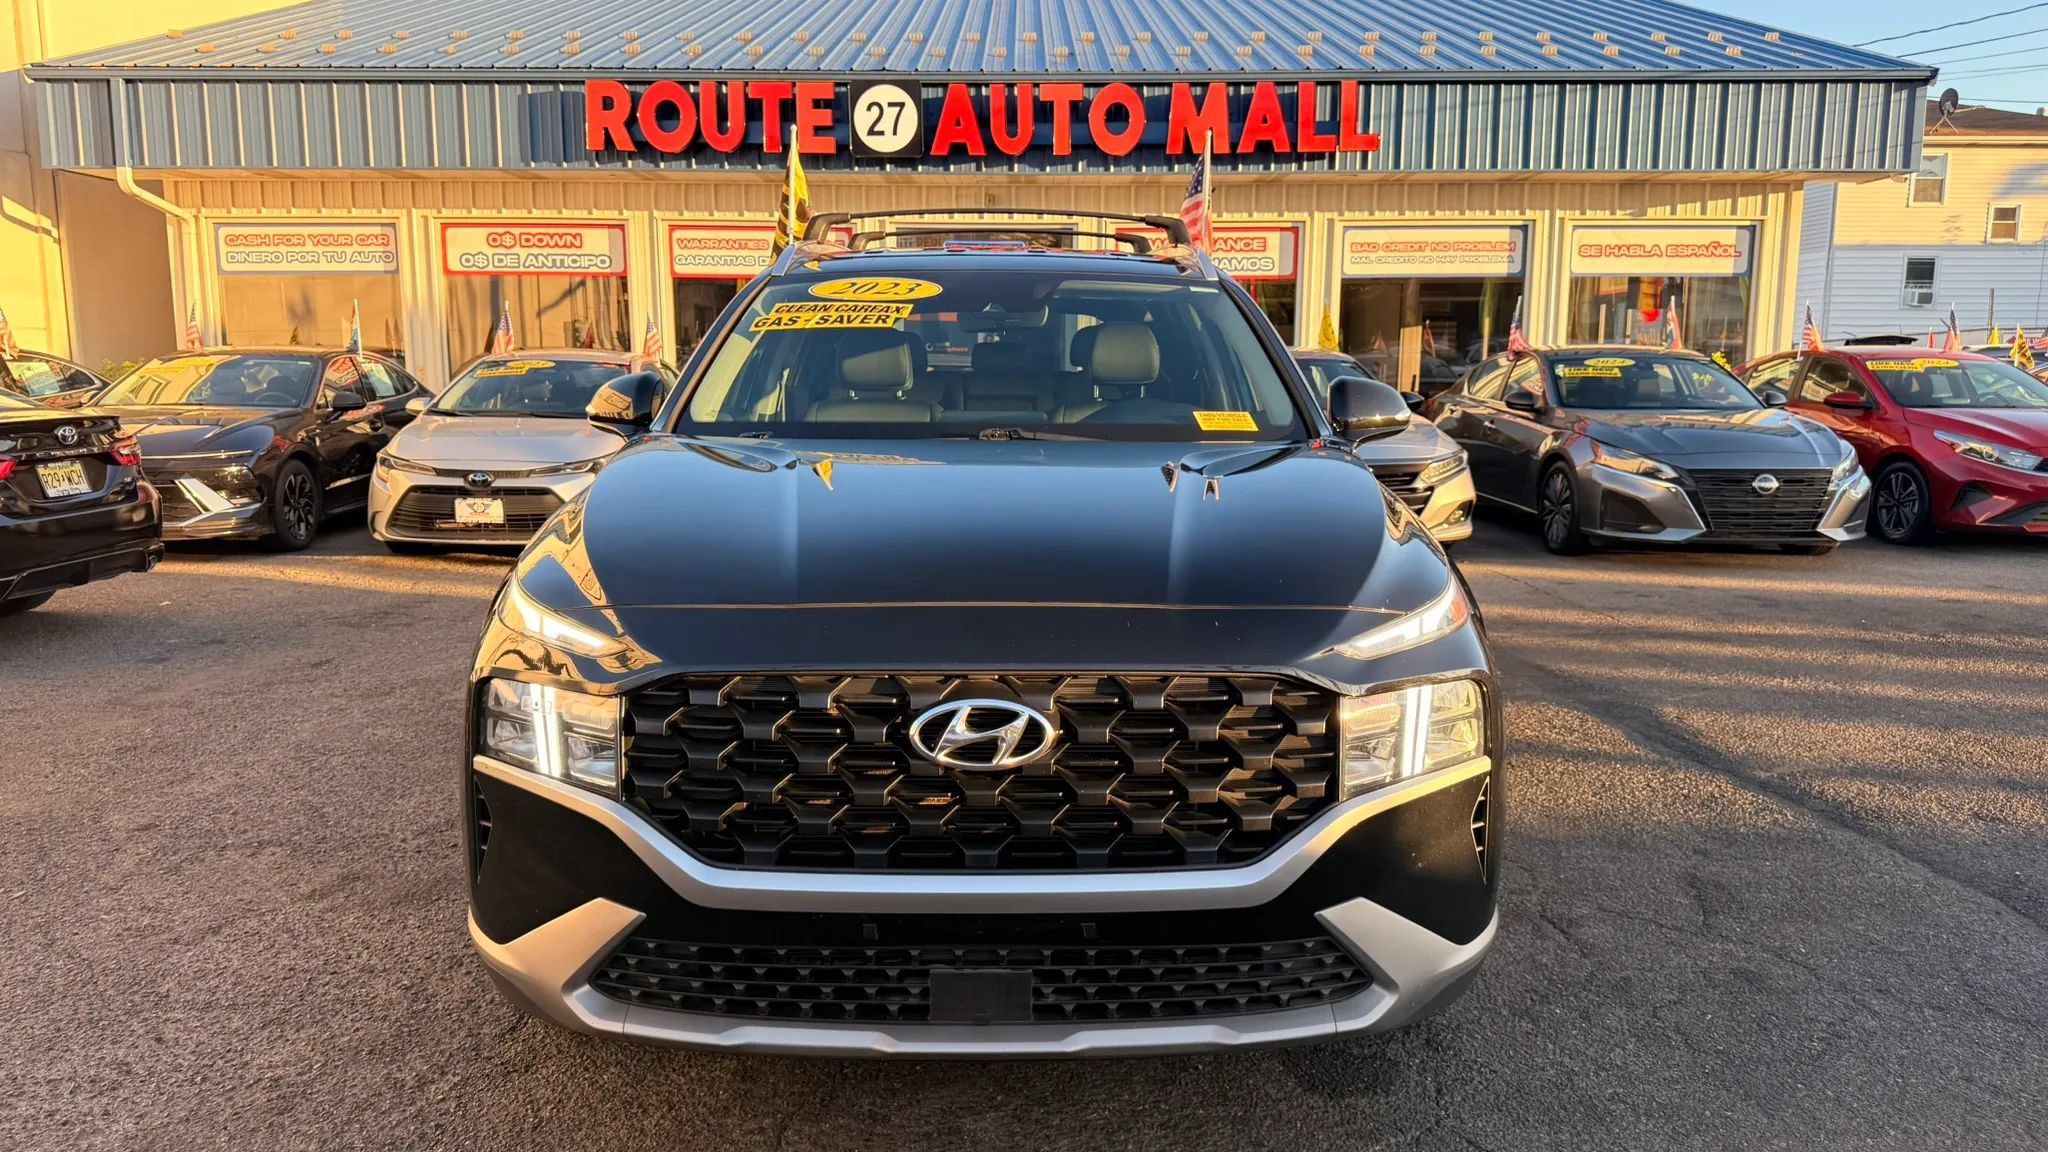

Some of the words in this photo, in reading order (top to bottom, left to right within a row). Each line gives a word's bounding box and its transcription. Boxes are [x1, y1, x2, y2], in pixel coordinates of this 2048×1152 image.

[585, 80, 837, 154] ROUTE
[865, 101, 906, 137] 27
[930, 82, 1147, 156] AUTO
[1165, 80, 1381, 155] MALL
[225, 234, 270, 246] CASH
[273, 234, 305, 246] FOR
[309, 234, 353, 246] YOUR
[356, 234, 389, 246] CAR
[519, 233, 582, 248] DOWN
[677, 238, 769, 250] WARRANTIES
[1351, 242, 1378, 252] BAD
[1382, 242, 1428, 252] CREDIT
[1431, 242, 1450, 252] NO
[1453, 241, 1516, 252] PROBLEM
[1578, 244, 1603, 257] SE
[1605, 244, 1663, 257] HABLA
[1666, 241, 1741, 257] ESPAÑOL
[226, 251, 283, 263] DINERO
[286, 251, 319, 263] POR
[323, 251, 346, 263] TU
[350, 251, 394, 263] AUTO
[492, 253, 520, 268] DE
[523, 253, 612, 269] ANTICIPO
[675, 255, 756, 266] GARANTIAS
[1351, 256, 1373, 264] MAL
[1419, 256, 1434, 264] NO
[1436, 256, 1457, 264] HAY
[828, 281, 922, 295] 2023
[775, 304, 834, 313] CLEAN
[835, 304, 907, 314] CARFAX
[753, 316, 800, 328] GAS
[815, 314, 890, 326] SAVER
